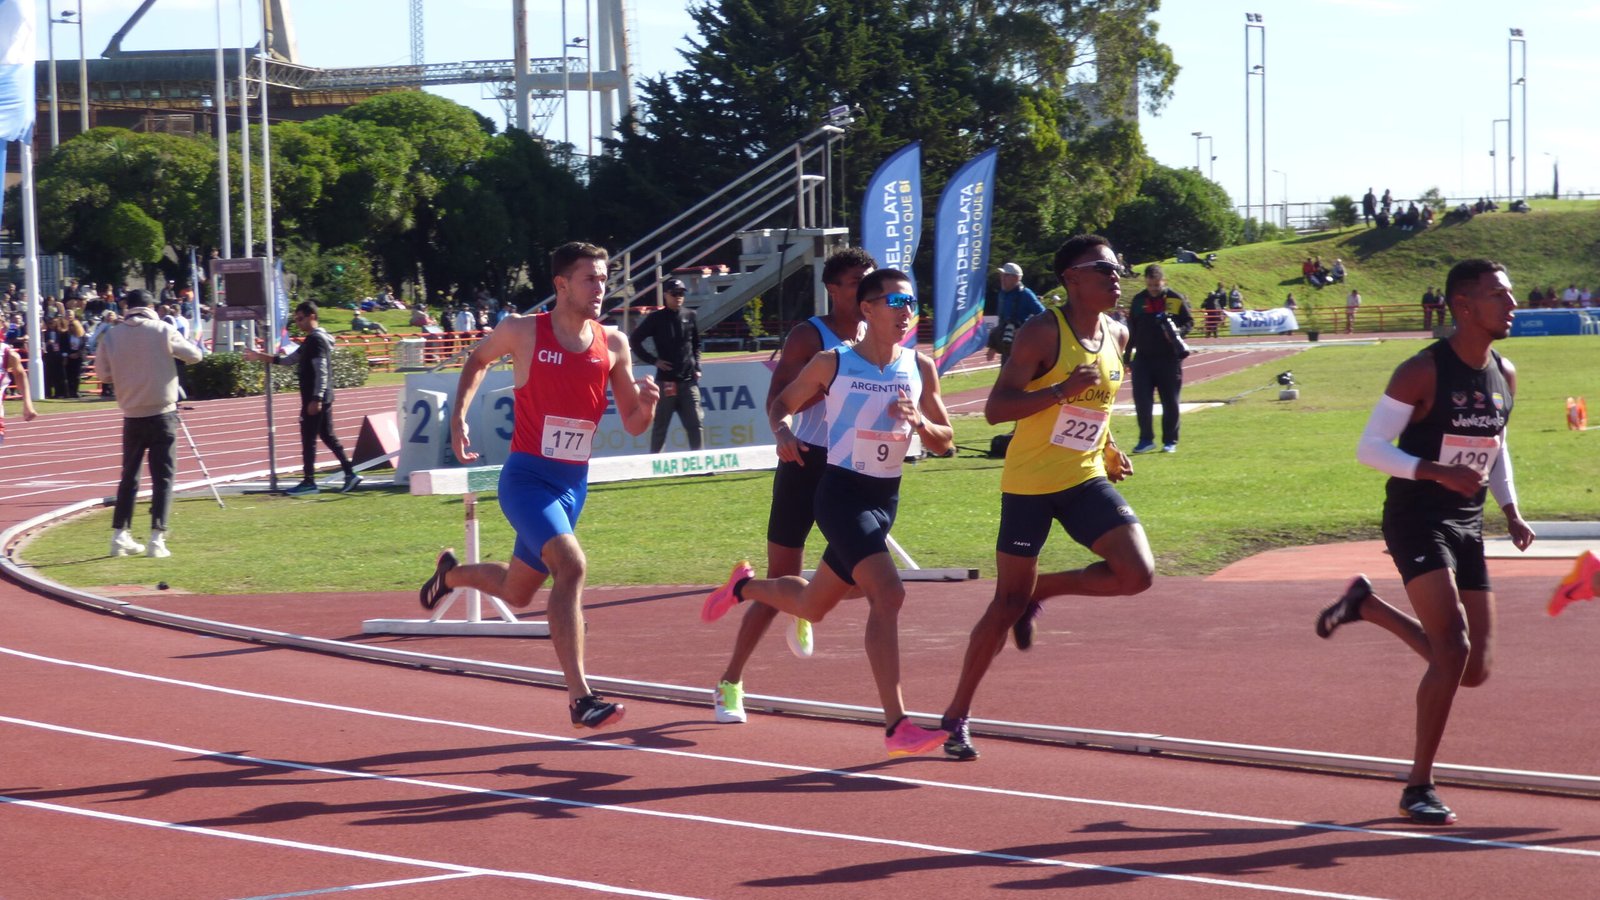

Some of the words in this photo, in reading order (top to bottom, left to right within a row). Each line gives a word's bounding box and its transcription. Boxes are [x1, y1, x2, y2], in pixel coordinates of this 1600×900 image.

[883, 180, 900, 238] PLATA
[901, 195, 914, 223] QUE
[957, 183, 975, 236] PLATA
[973, 195, 984, 221] QUE
[902, 225, 914, 242] LO
[972, 222, 983, 238] LO
[901, 244, 913, 273] ODO
[956, 237, 969, 271] DEL
[971, 240, 983, 272] TODO
[956, 273, 969, 311] MAR
[538, 349, 563, 365] CHI
[700, 385, 757, 411] ATA
[850, 381, 912, 393] ARGENTINA
[408, 399, 432, 444] 2
[494, 396, 515, 441] 3
[1061, 419, 1099, 442] 222
[552, 430, 585, 451] 177
[876, 444, 889, 462] 9
[652, 458, 678, 475] MAR
[682, 456, 703, 473] DEL
[705, 453, 740, 469] PLATA
[1448, 450, 1489, 471] 429
